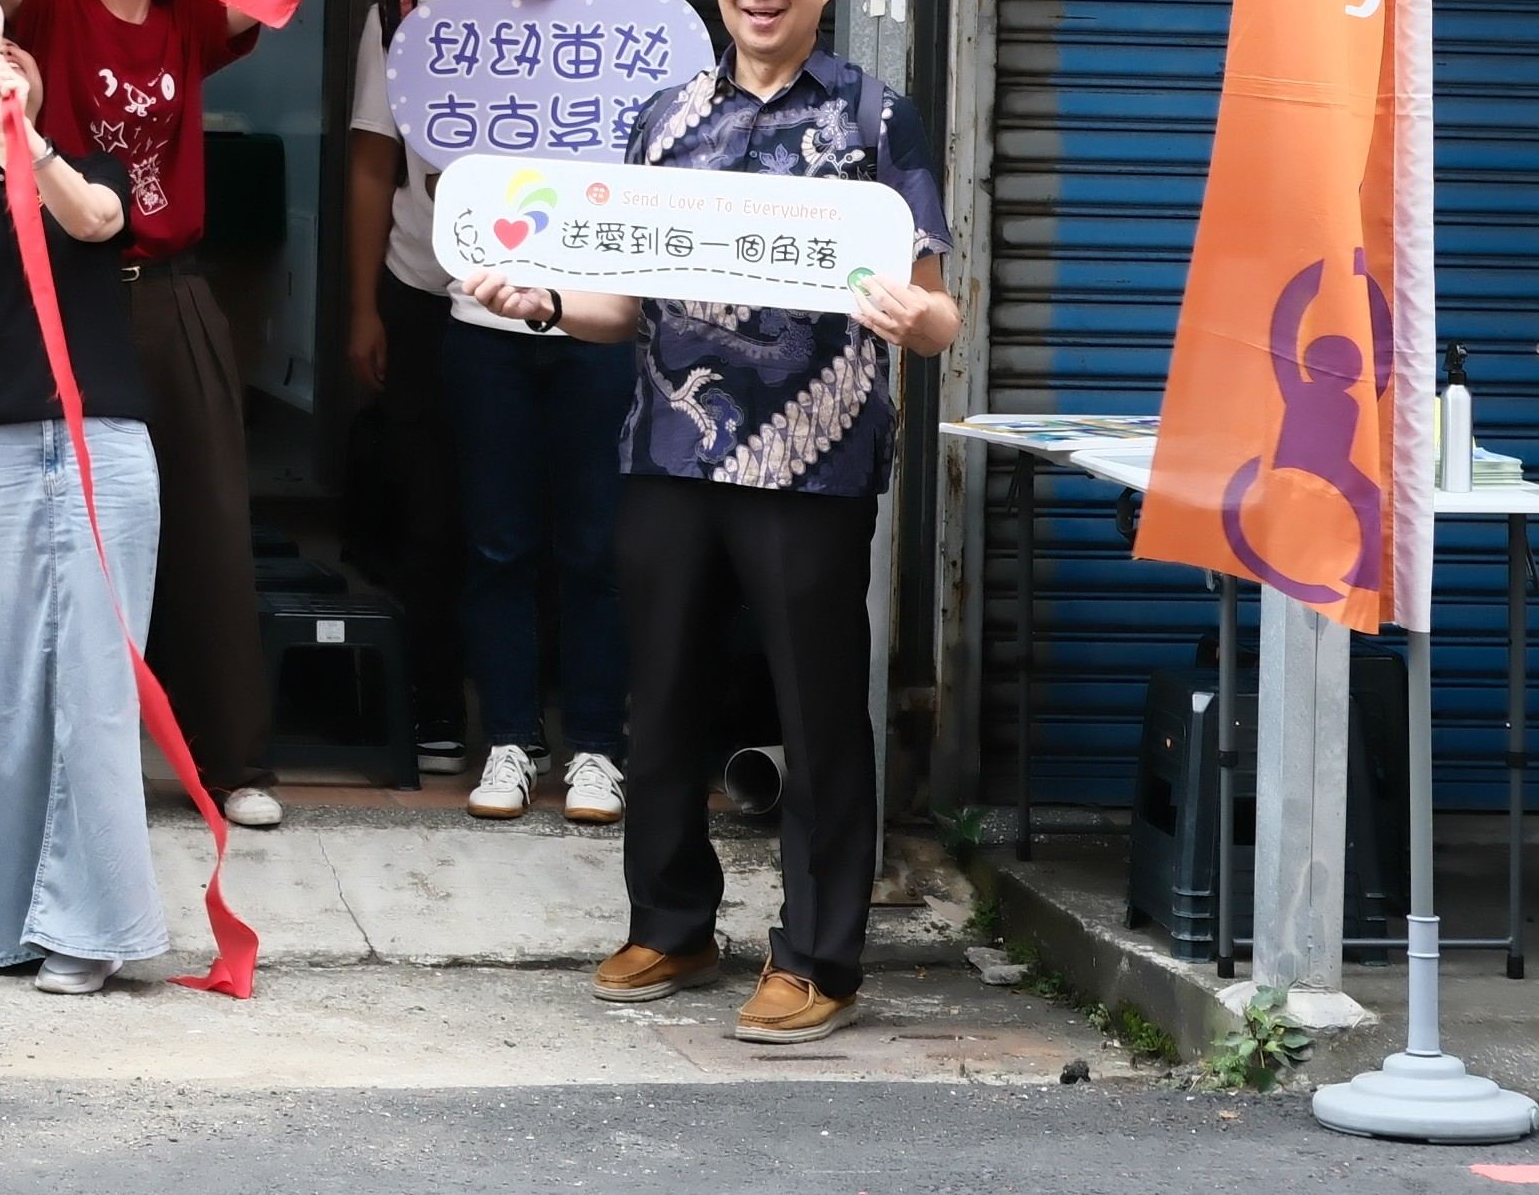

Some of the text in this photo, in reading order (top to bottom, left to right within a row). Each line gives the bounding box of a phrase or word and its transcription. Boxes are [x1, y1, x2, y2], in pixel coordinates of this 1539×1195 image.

[429, 21, 669, 81] 效果好好
[622, 190, 843, 221] Send Love To Everywhere.
[561, 219, 838, 270] 送愛到每一個角落
